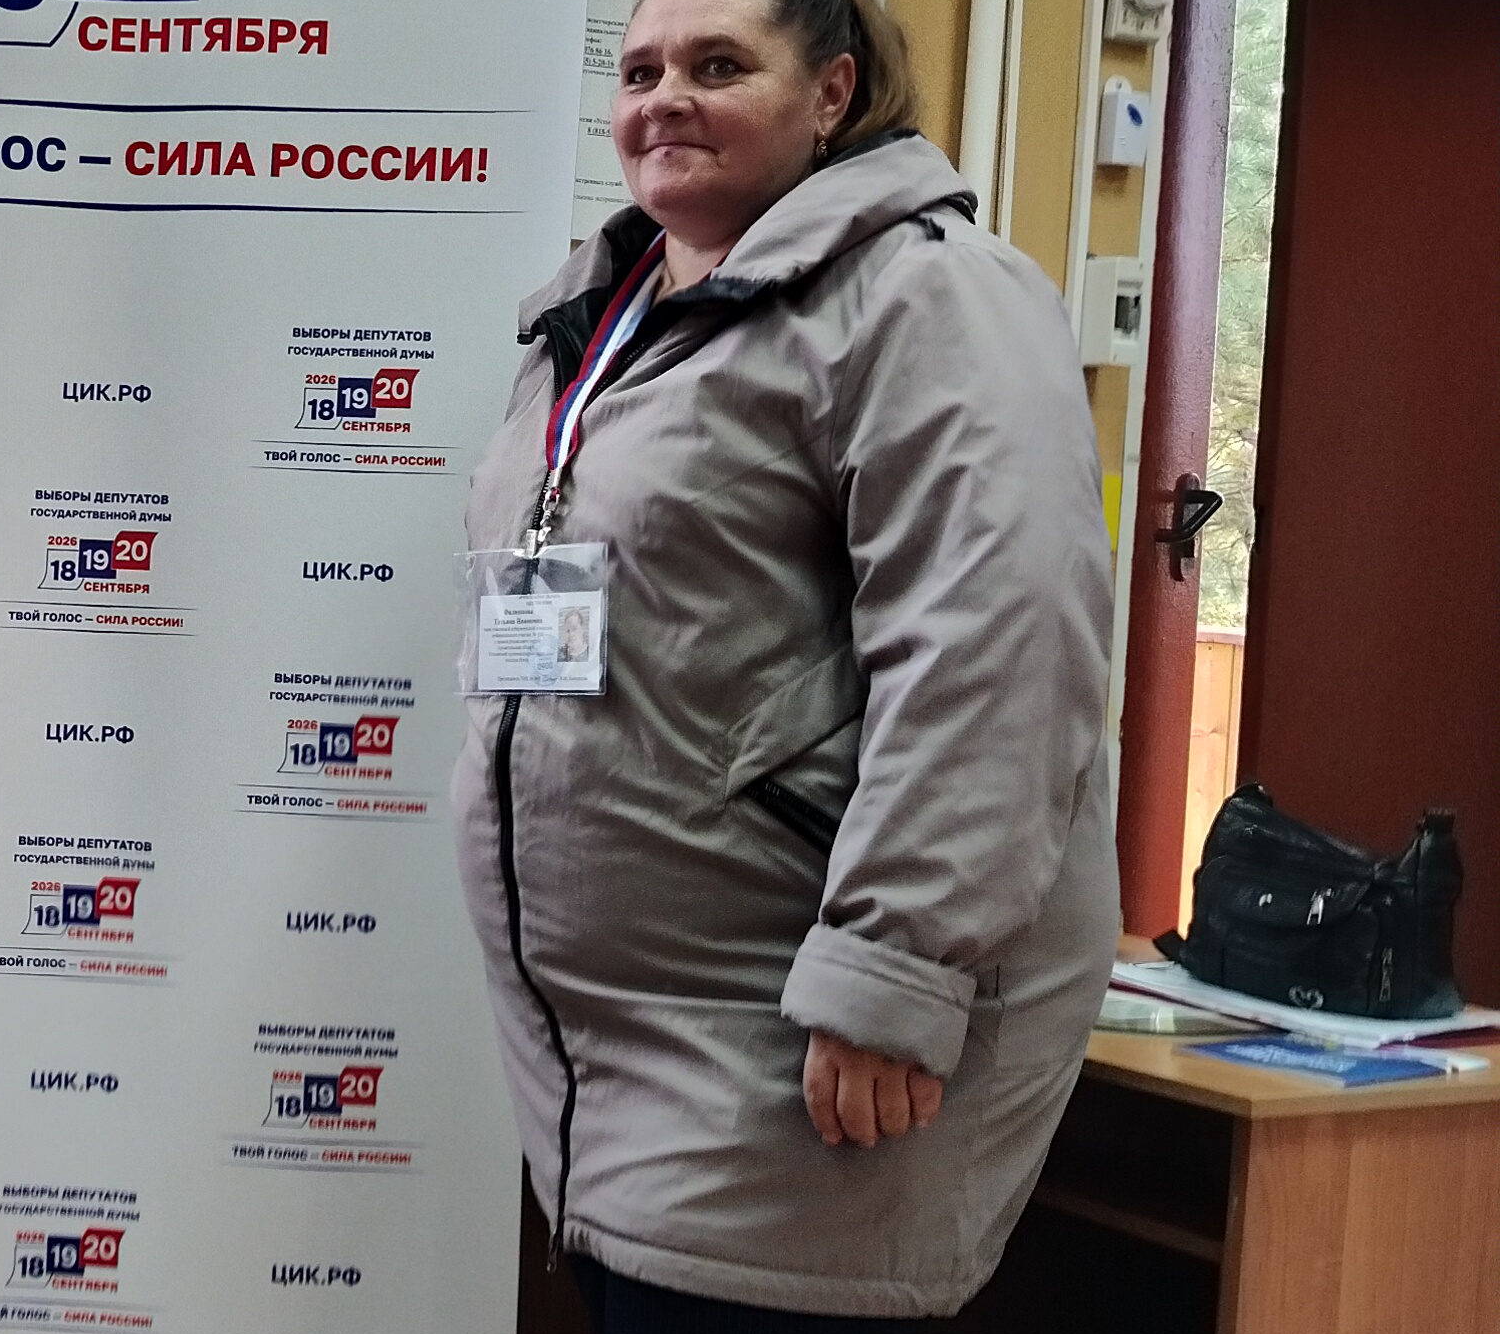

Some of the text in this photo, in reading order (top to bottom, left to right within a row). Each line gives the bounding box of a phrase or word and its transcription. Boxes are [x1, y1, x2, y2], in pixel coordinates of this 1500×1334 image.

[77, 16, 329, 55] СЕНТЯБРЯ
[124, 140, 256, 178] СИЛА
[270, 143, 488, 183] РОССИИ!
[292, 328, 431, 342] ВЫБОРЫ ДЕПУТАТОВ
[288, 346, 434, 359] ГОСУДАРСТВЕННОЙ ДУМЫ
[305, 375, 336, 384] 2026
[62, 382, 152, 403] ЦИК.РФ
[308, 378, 409, 420] 18 19 20
[342, 421, 410, 432] СЕНТЯБРЯ
[265, 450, 445, 466] ТВОЙ ГОЛОС СИЛА РОССИИ!
[35, 490, 169, 504] ВЫБОРЫ ДЕПУТАТОВ
[31, 508, 171, 522] ГОСУДАРСТВЕННОЙ ДУМЫ
[48, 536, 77, 546] 2026
[50, 540, 148, 581] 18 19 20
[302, 561, 394, 583] ЦИК.РФ
[84, 582, 149, 593] СЕНТЯБРЯ
[9, 610, 183, 627] ТВОЙ ГОЛОС СИЛА РОССИИ!
[274, 673, 411, 690] ВЫБОРЫ ДЕПУТАТОВ
[270, 692, 378, 706] ГОСУДАРСТВЕННОЙ
[45, 723, 135, 744] ЦИК.РФ
[287, 720, 317, 730] 2026
[290, 724, 389, 765] 18 19 20
[247, 794, 279, 806] ТВОЙ
[283, 797, 322, 807] ГОЛОС
[19, 836, 152, 851] ВЫБОРЫ ДЕПУТАТОВ
[14, 854, 120, 867] ГОСУДАРСТВЕННОЙ
[34, 886, 131, 926] 18 19 20
[286, 912, 377, 935] ЦИК.РФ
[27, 958, 65, 968] ГОЛОС
[30, 1071, 119, 1094] ЦИК.РФ
[308, 1083, 334, 1108] 19
[341, 1075, 374, 1098] 20
[18, 1235, 116, 1278] 18 19 20
[271, 1264, 362, 1288] ЦИК.РФ
